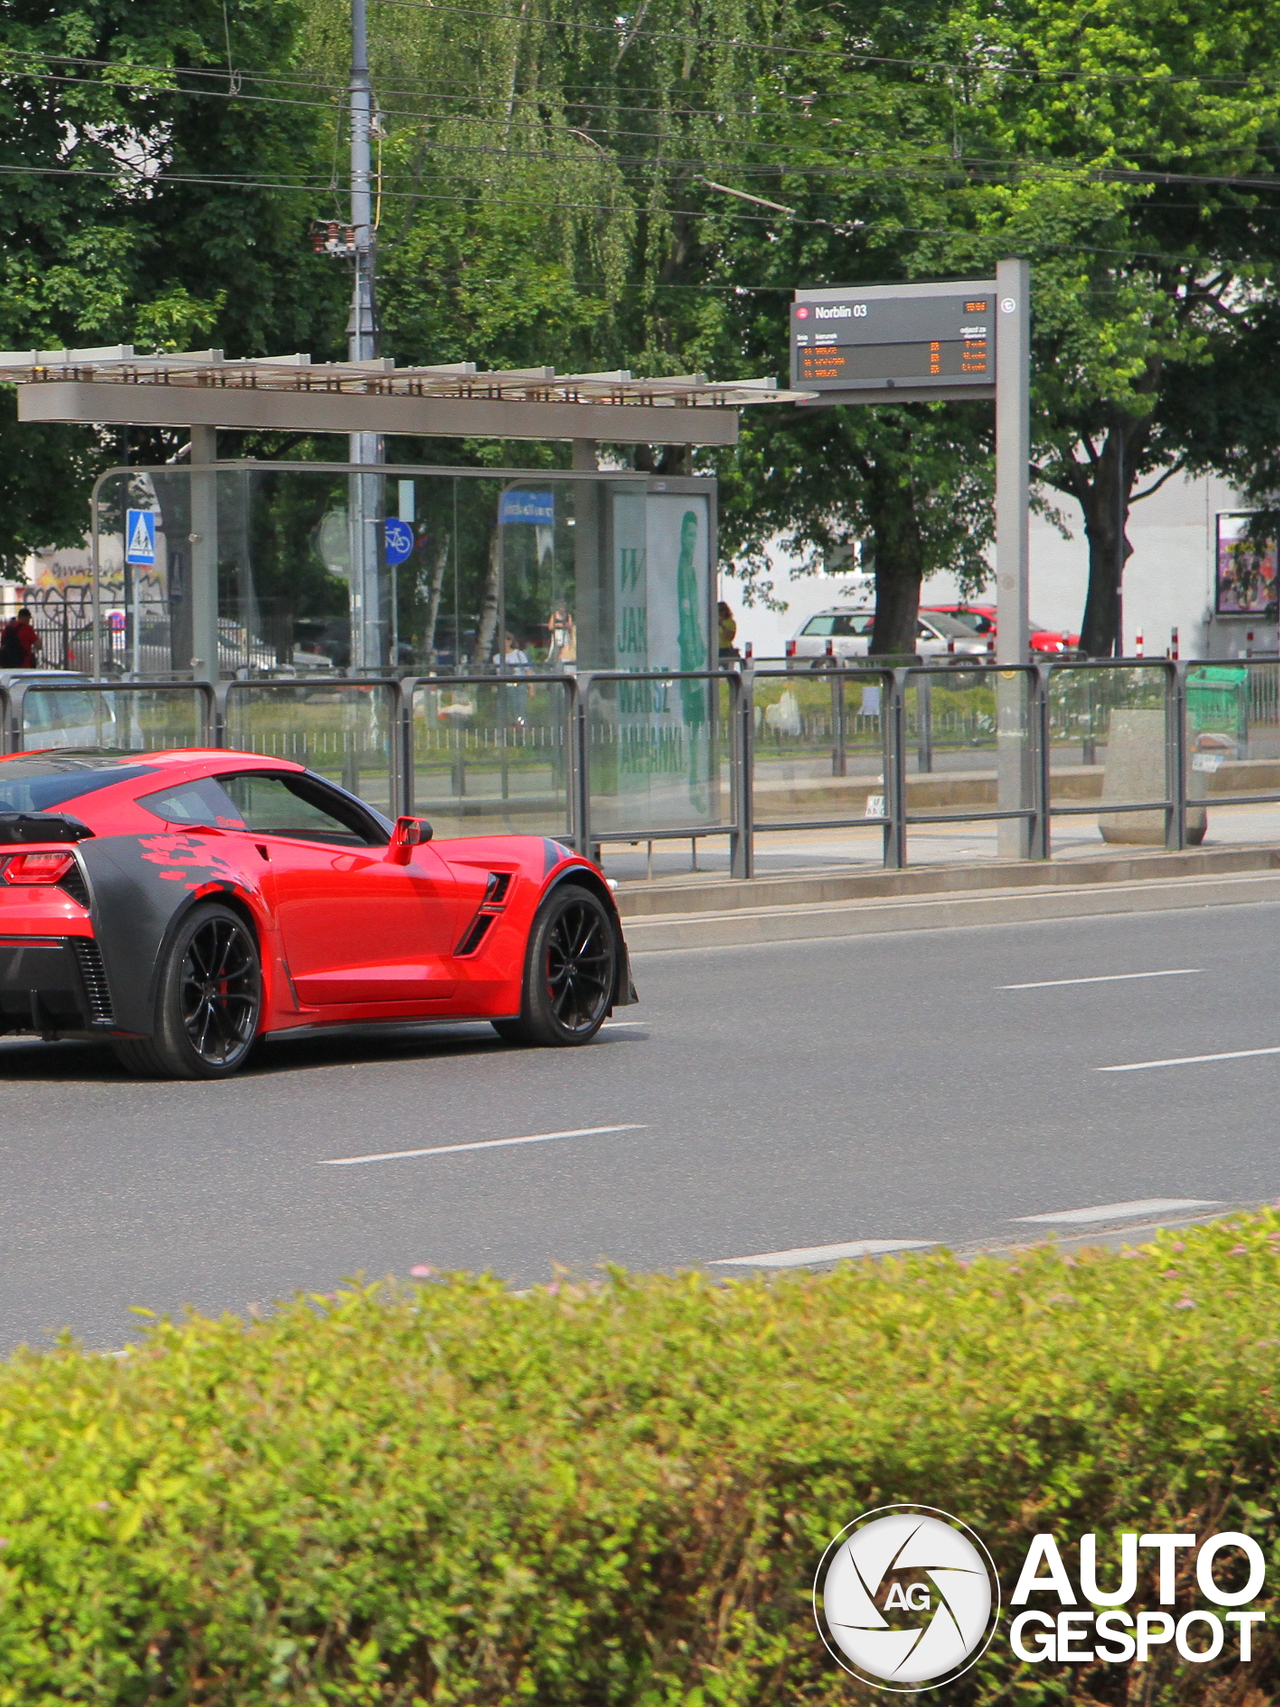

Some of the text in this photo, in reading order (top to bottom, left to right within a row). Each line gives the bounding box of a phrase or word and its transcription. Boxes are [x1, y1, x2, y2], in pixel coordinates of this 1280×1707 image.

[815, 304, 867, 319] Norblin 03
[620, 548, 646, 592] W
